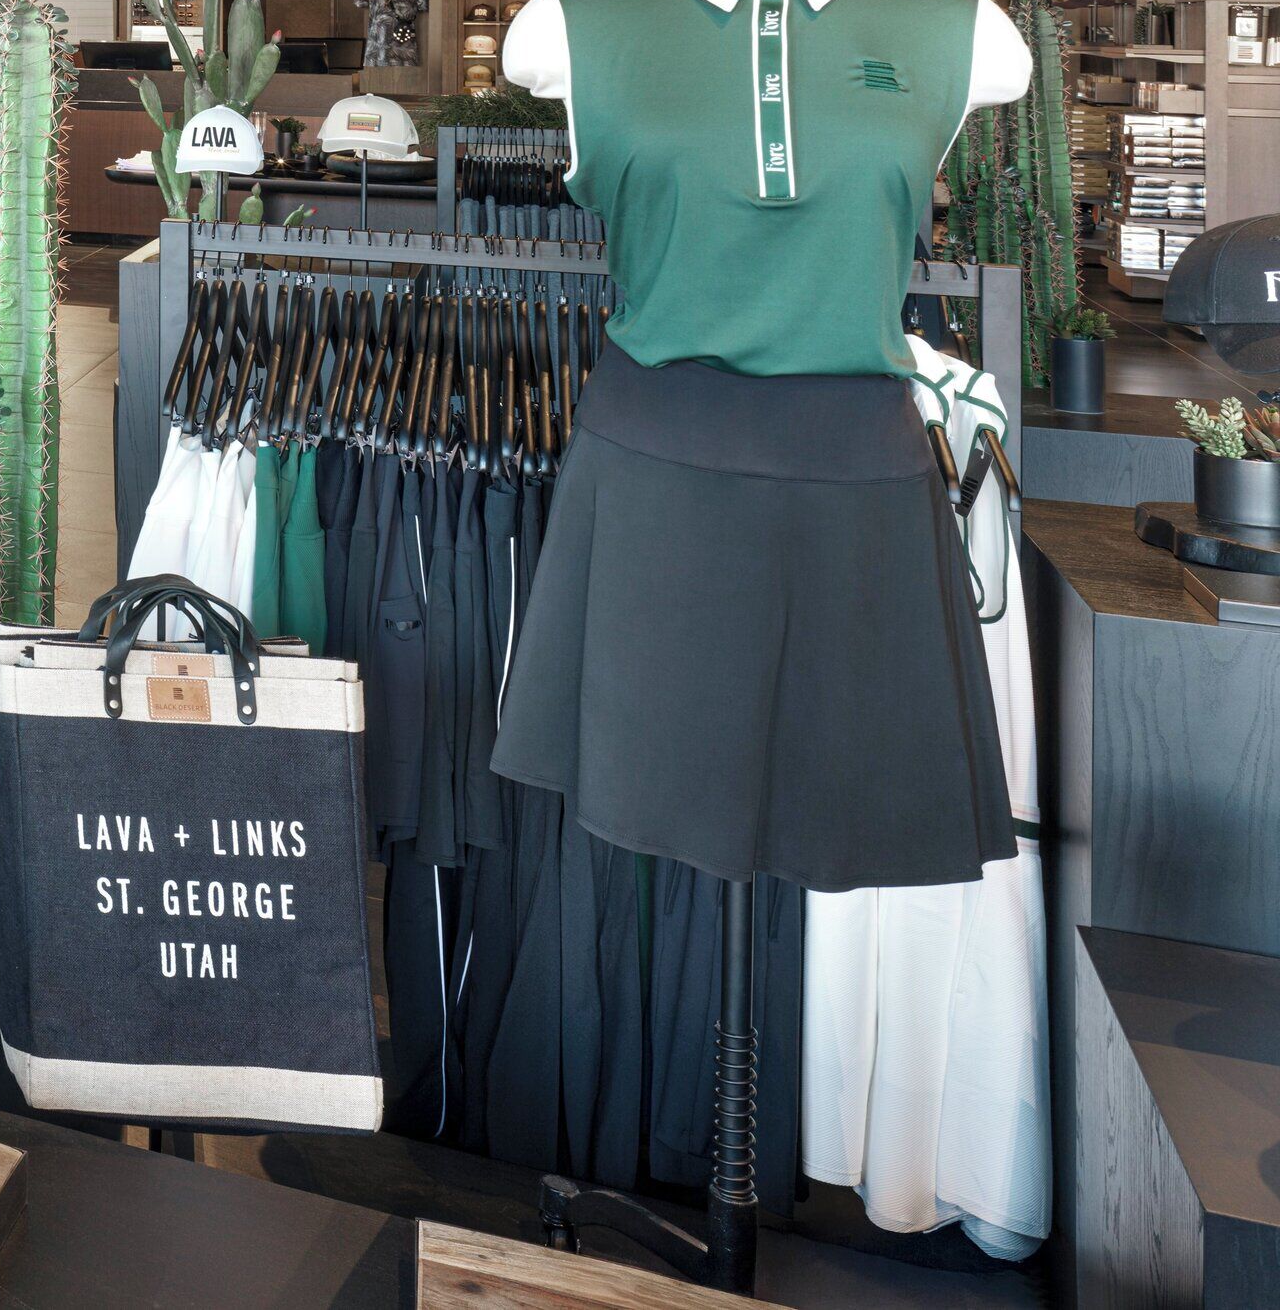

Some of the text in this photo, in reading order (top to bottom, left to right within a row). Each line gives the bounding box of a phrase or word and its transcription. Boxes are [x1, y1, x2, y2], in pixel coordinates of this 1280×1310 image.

[760, 10, 780, 37] Fore
[761, 73, 782, 103] Fore
[191, 126, 237, 148] LAVA
[765, 142, 786, 173] Fore
[155, 703, 204, 712] BLACK DESERT
[77, 813, 307, 857] LAVA + LINKS
[96, 876, 296, 920] ST. GEORGE
[160, 941, 238, 979] UTAH
